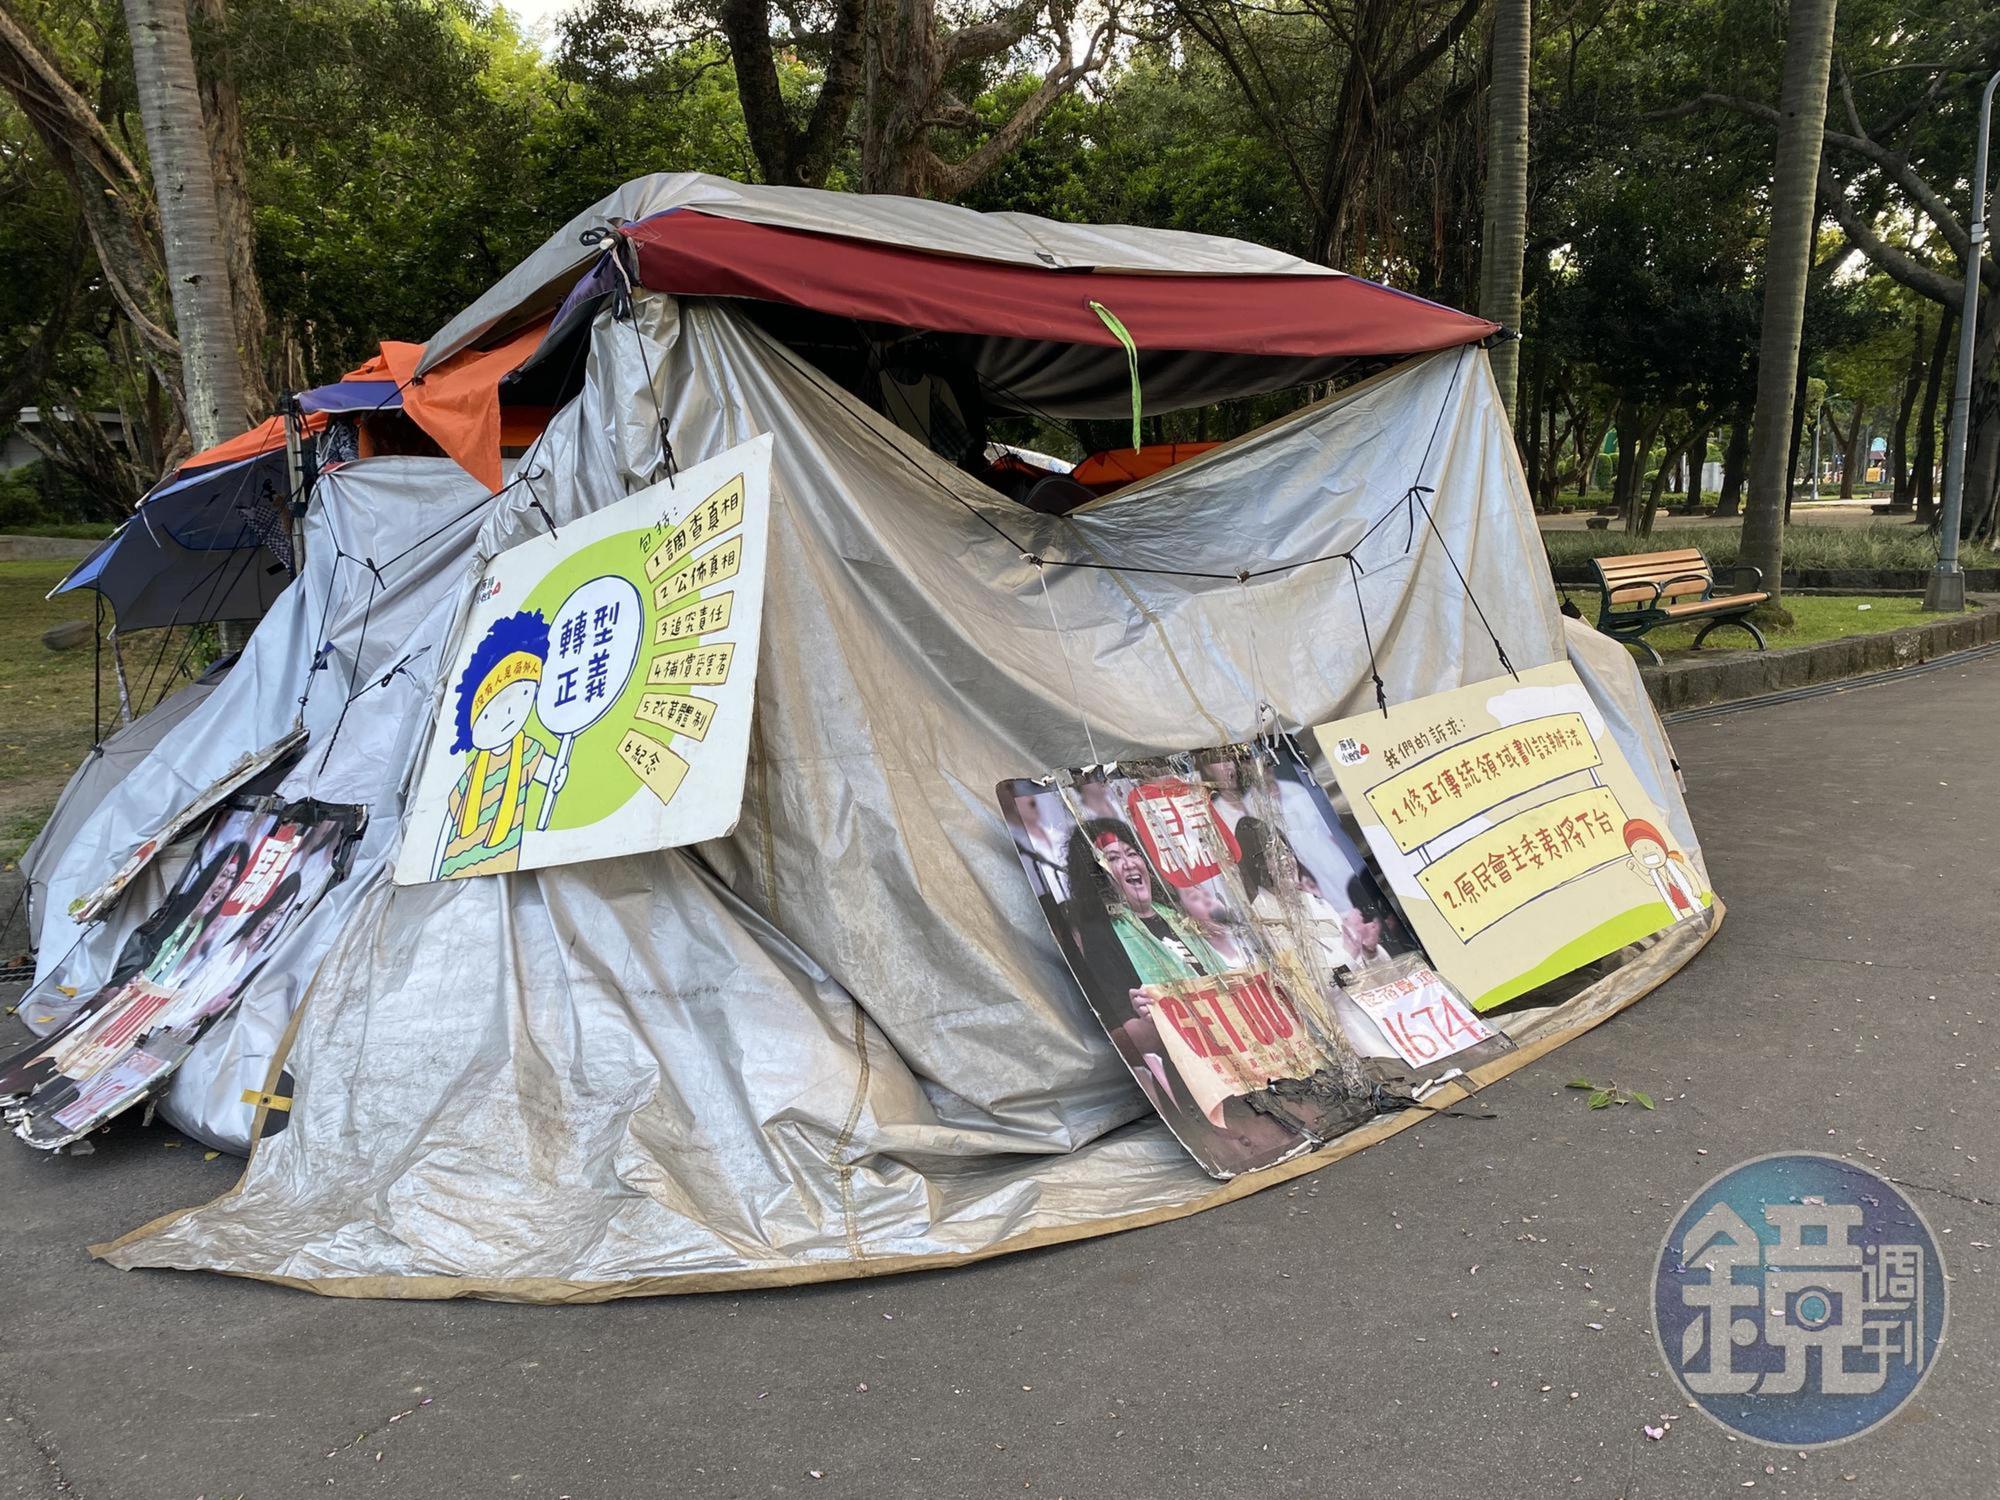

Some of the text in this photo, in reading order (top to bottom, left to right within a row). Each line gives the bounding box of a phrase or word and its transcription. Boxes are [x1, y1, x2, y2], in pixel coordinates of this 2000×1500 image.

[559, 600, 621, 660] 轉型
[553, 650, 611, 708] 正義
[1158, 986, 1249, 1059] GET
[1382, 994, 1483, 1065] 1674
